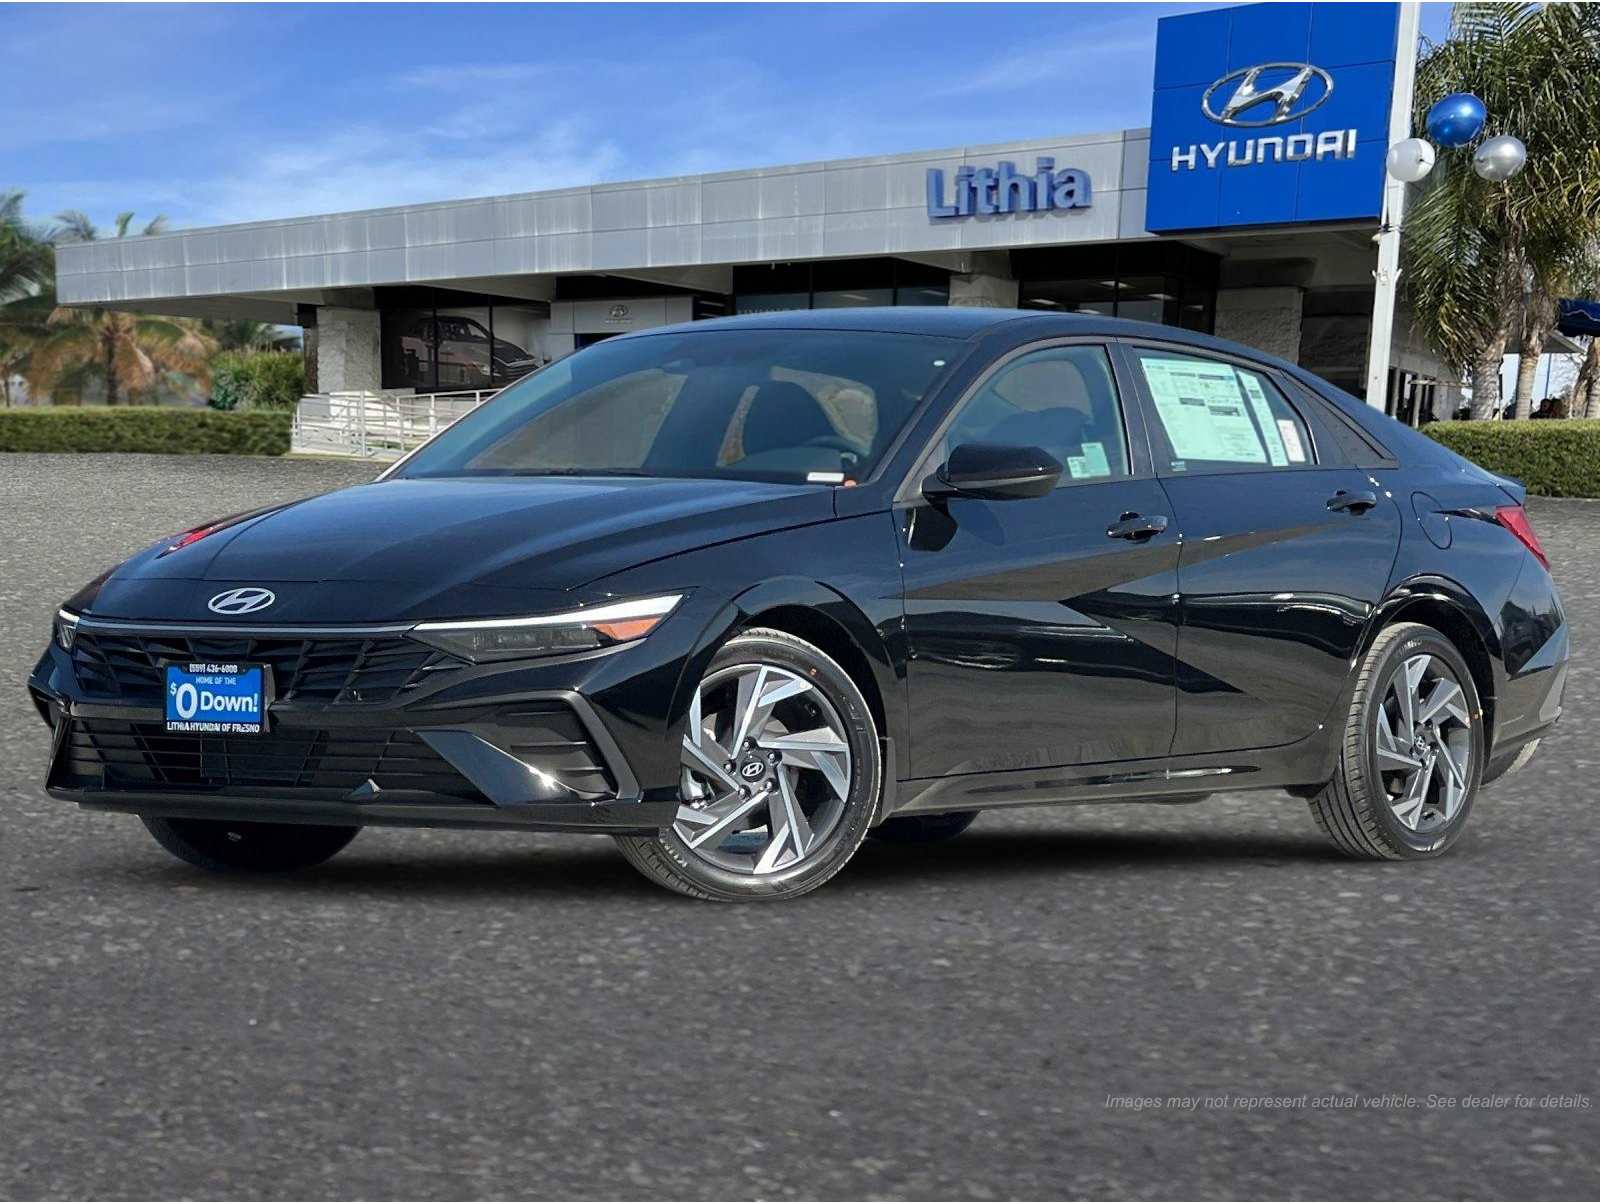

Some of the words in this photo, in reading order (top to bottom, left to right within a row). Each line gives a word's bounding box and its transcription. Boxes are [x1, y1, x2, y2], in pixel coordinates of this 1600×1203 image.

[1171, 129, 1357, 171] HYUNDAI
[926, 157, 1092, 219] Lithia
[196, 676, 213, 684] HOME
[225, 677, 236, 685] THE
[200, 691, 259, 712] Down!
[167, 721, 189, 731] LITHIA
[190, 722, 220, 732] HYUNDAI
[222, 724, 231, 732] OF
[232, 724, 259, 732] FRESNO
